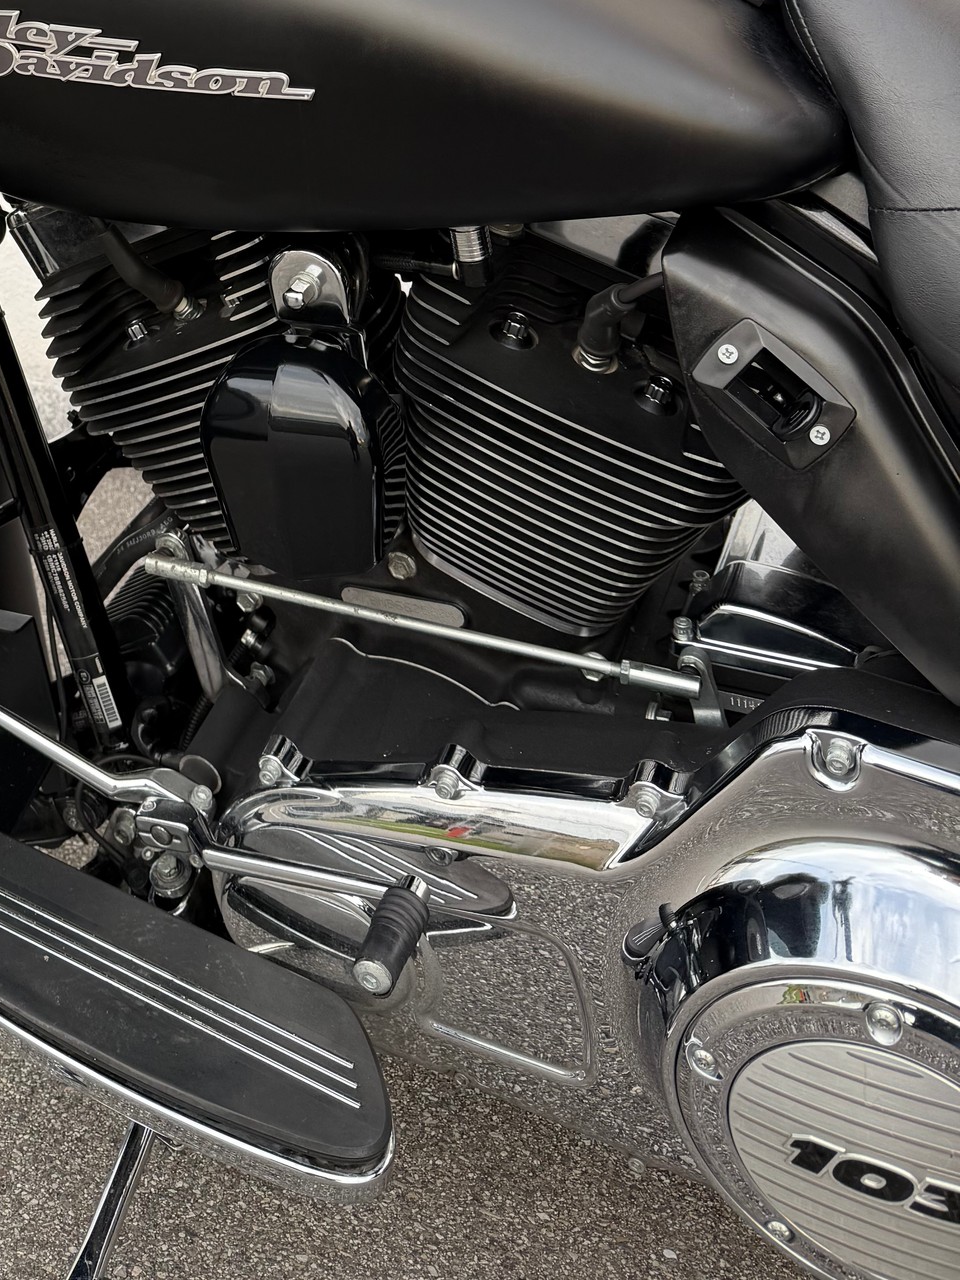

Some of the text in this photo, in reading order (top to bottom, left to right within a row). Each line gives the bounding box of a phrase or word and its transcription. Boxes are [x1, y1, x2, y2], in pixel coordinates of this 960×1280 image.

[67, 580, 78, 601] MOTOR
[74, 601, 88, 628] COMPANY
[786, 1134, 960, 1224] 103
